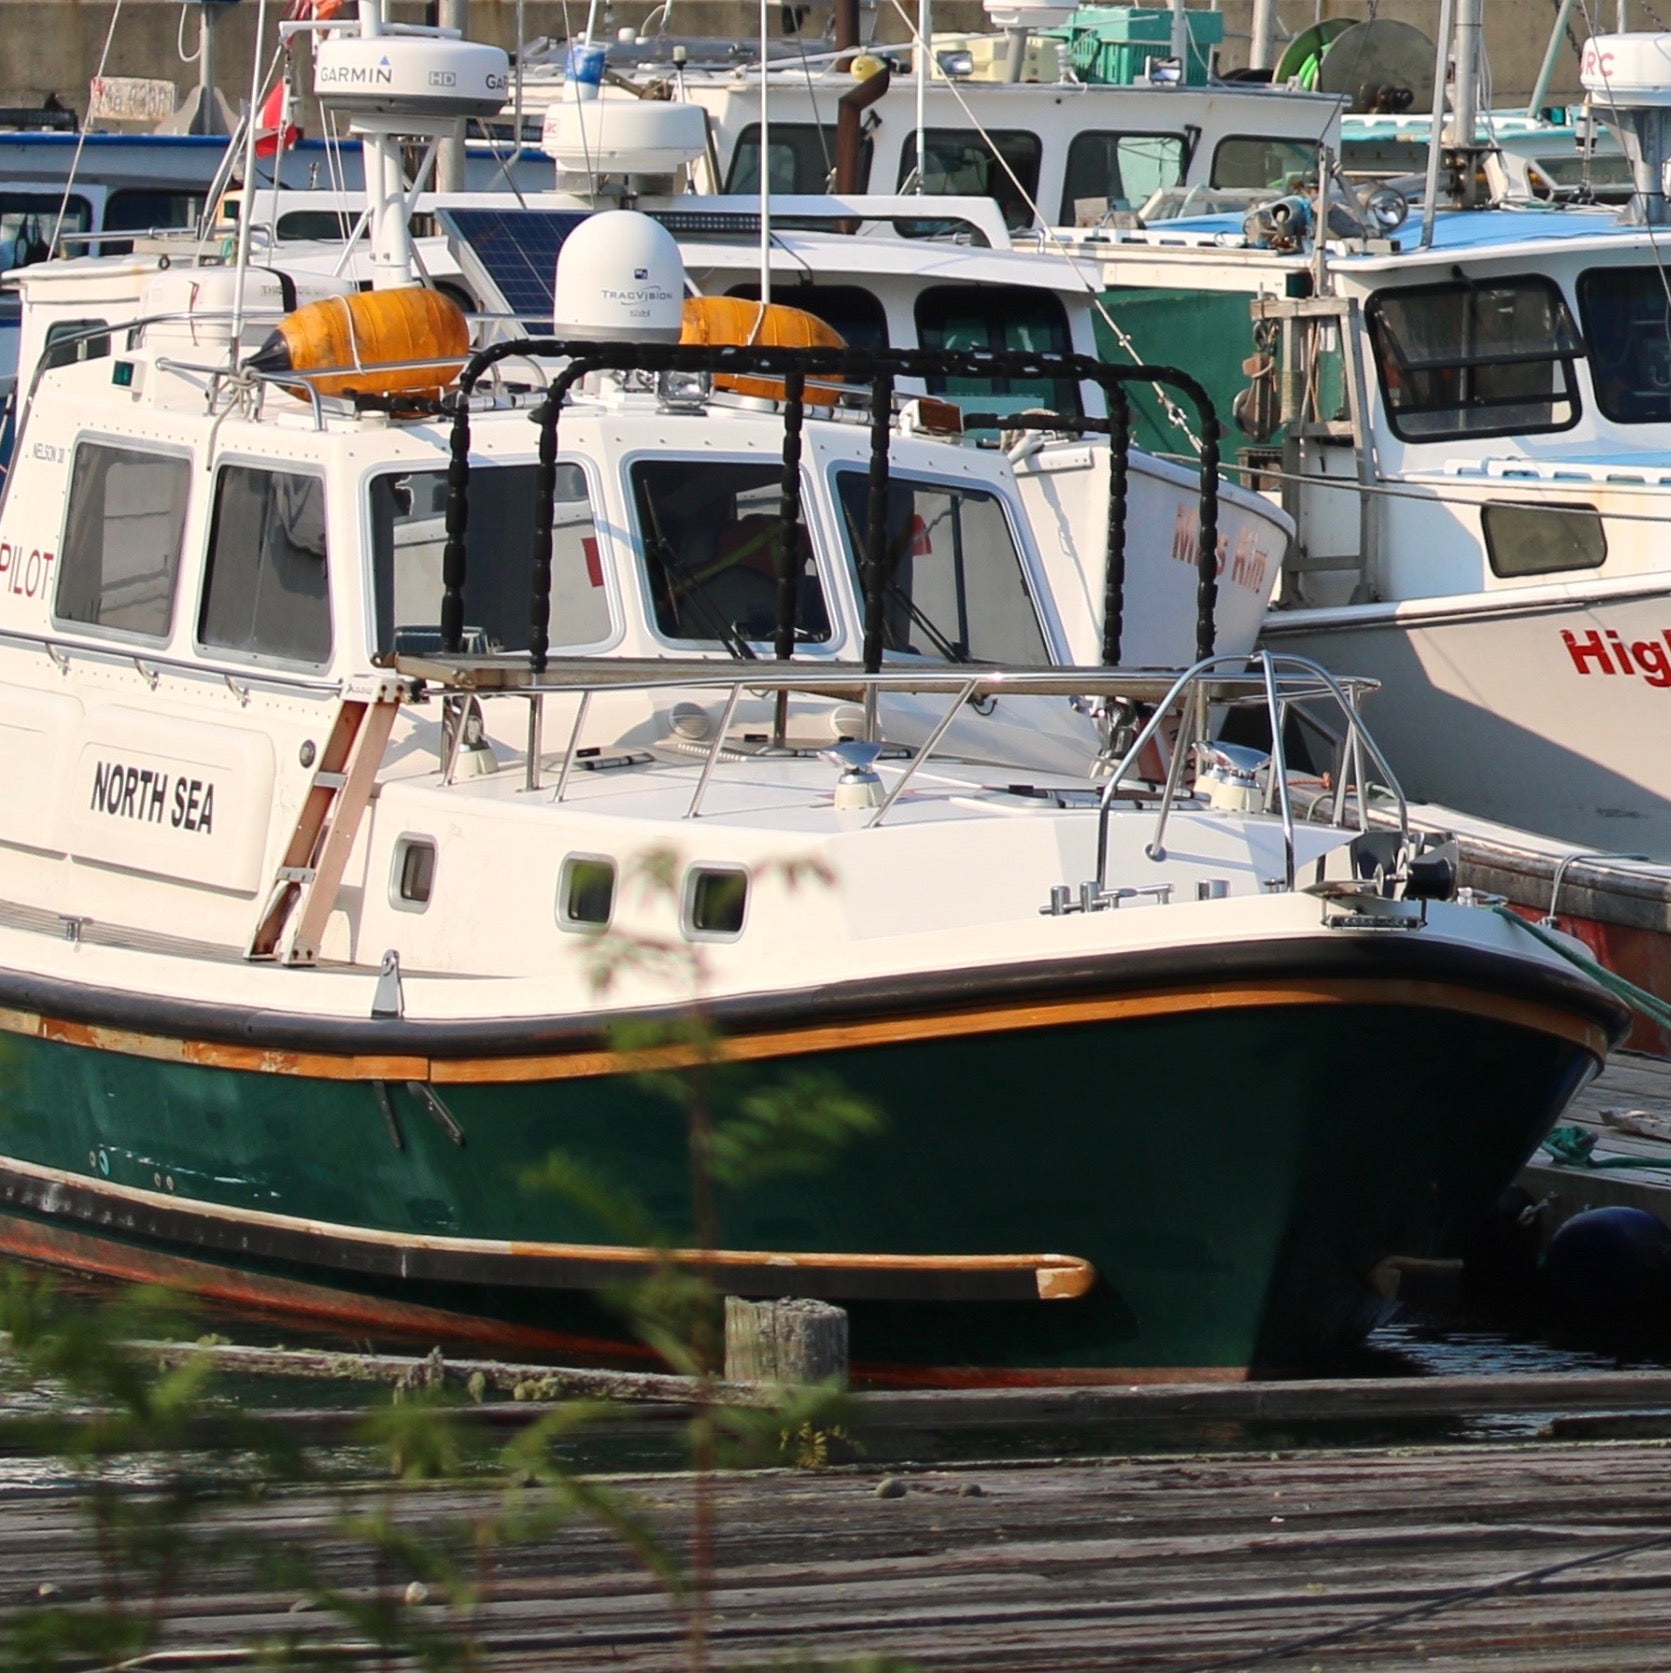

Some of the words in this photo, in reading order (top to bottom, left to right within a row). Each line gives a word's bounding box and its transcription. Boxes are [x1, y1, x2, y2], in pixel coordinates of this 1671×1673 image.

[320, 66, 392, 84] GARMIN
[1583, 51, 1615, 77] RC
[431, 71, 455, 86] HD
[0, 542, 54, 600] PILOT
[90, 760, 168, 824] NORTH
[171, 776, 214, 835] SEA
